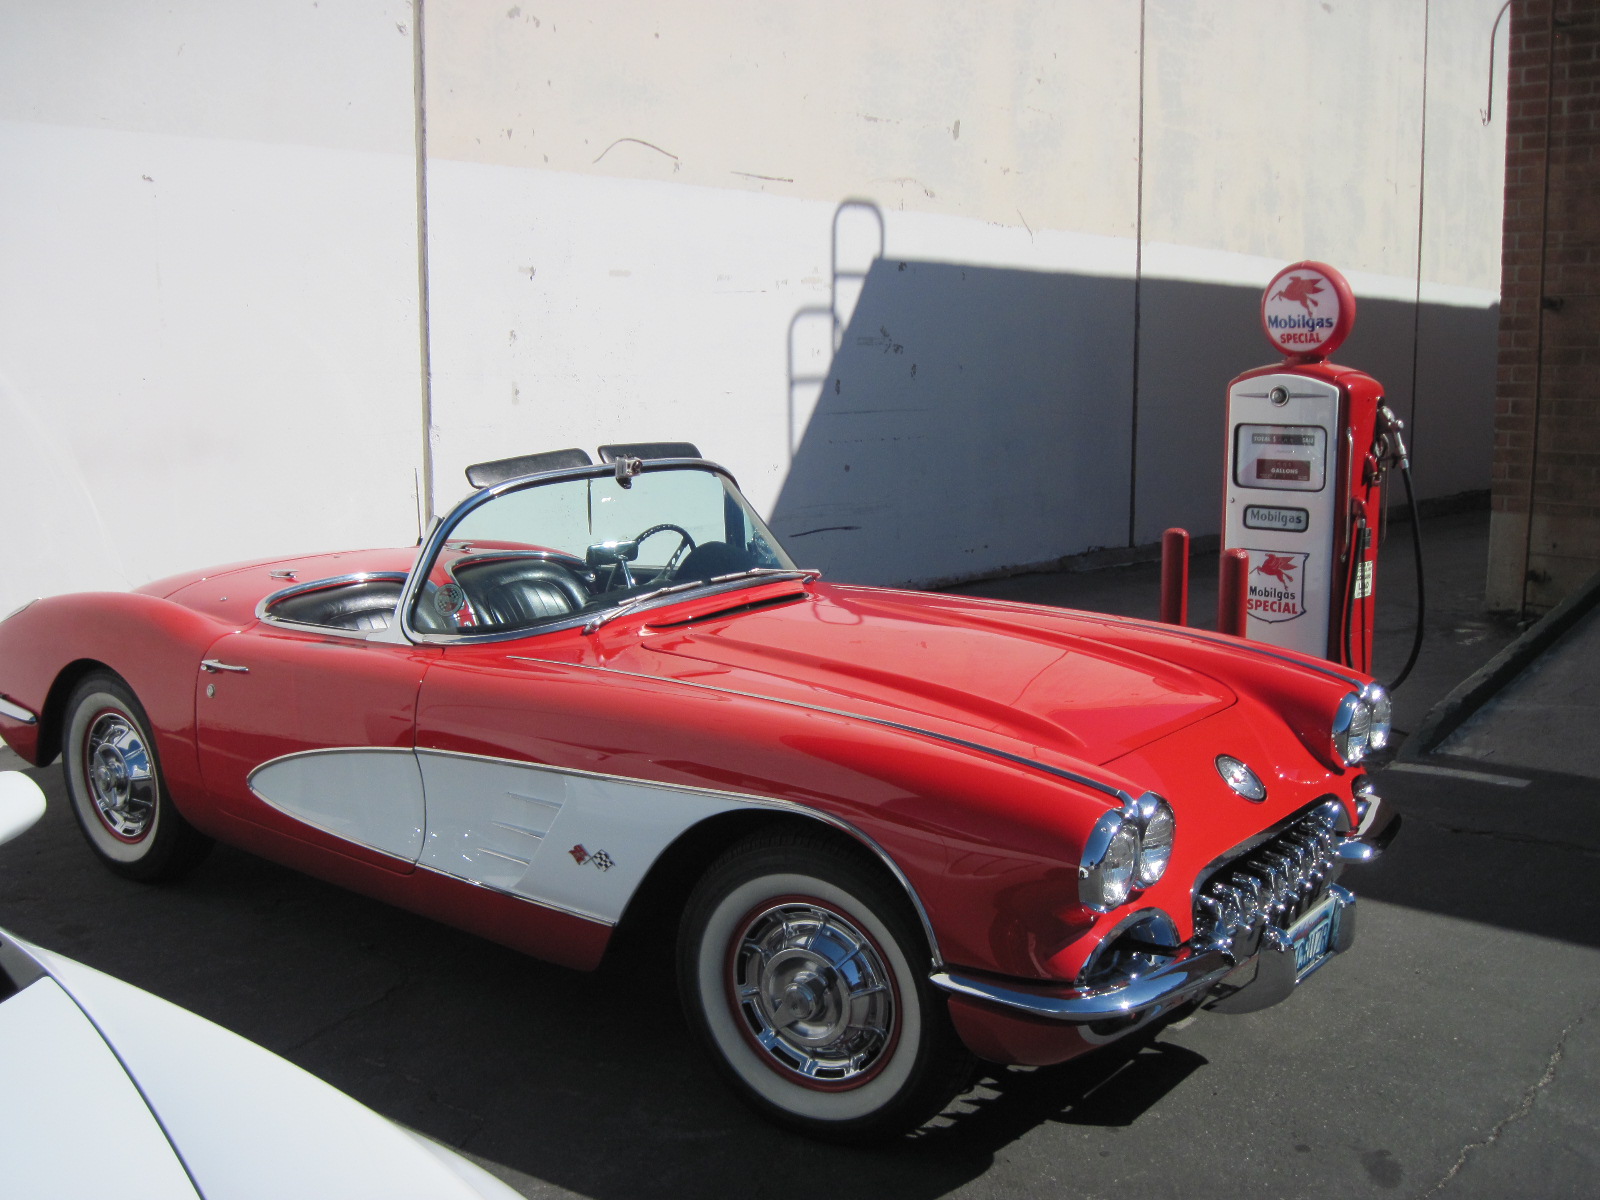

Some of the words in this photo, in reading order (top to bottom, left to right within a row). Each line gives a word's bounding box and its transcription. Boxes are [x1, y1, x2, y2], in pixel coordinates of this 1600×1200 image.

[1267, 314, 1334, 332] Mobilgas
[1280, 333, 1322, 343] SPECIAL
[1250, 509, 1302, 527] Mobilgas
[1249, 586, 1296, 602] Mobilgas
[1247, 598, 1298, 615] SPECIAL
